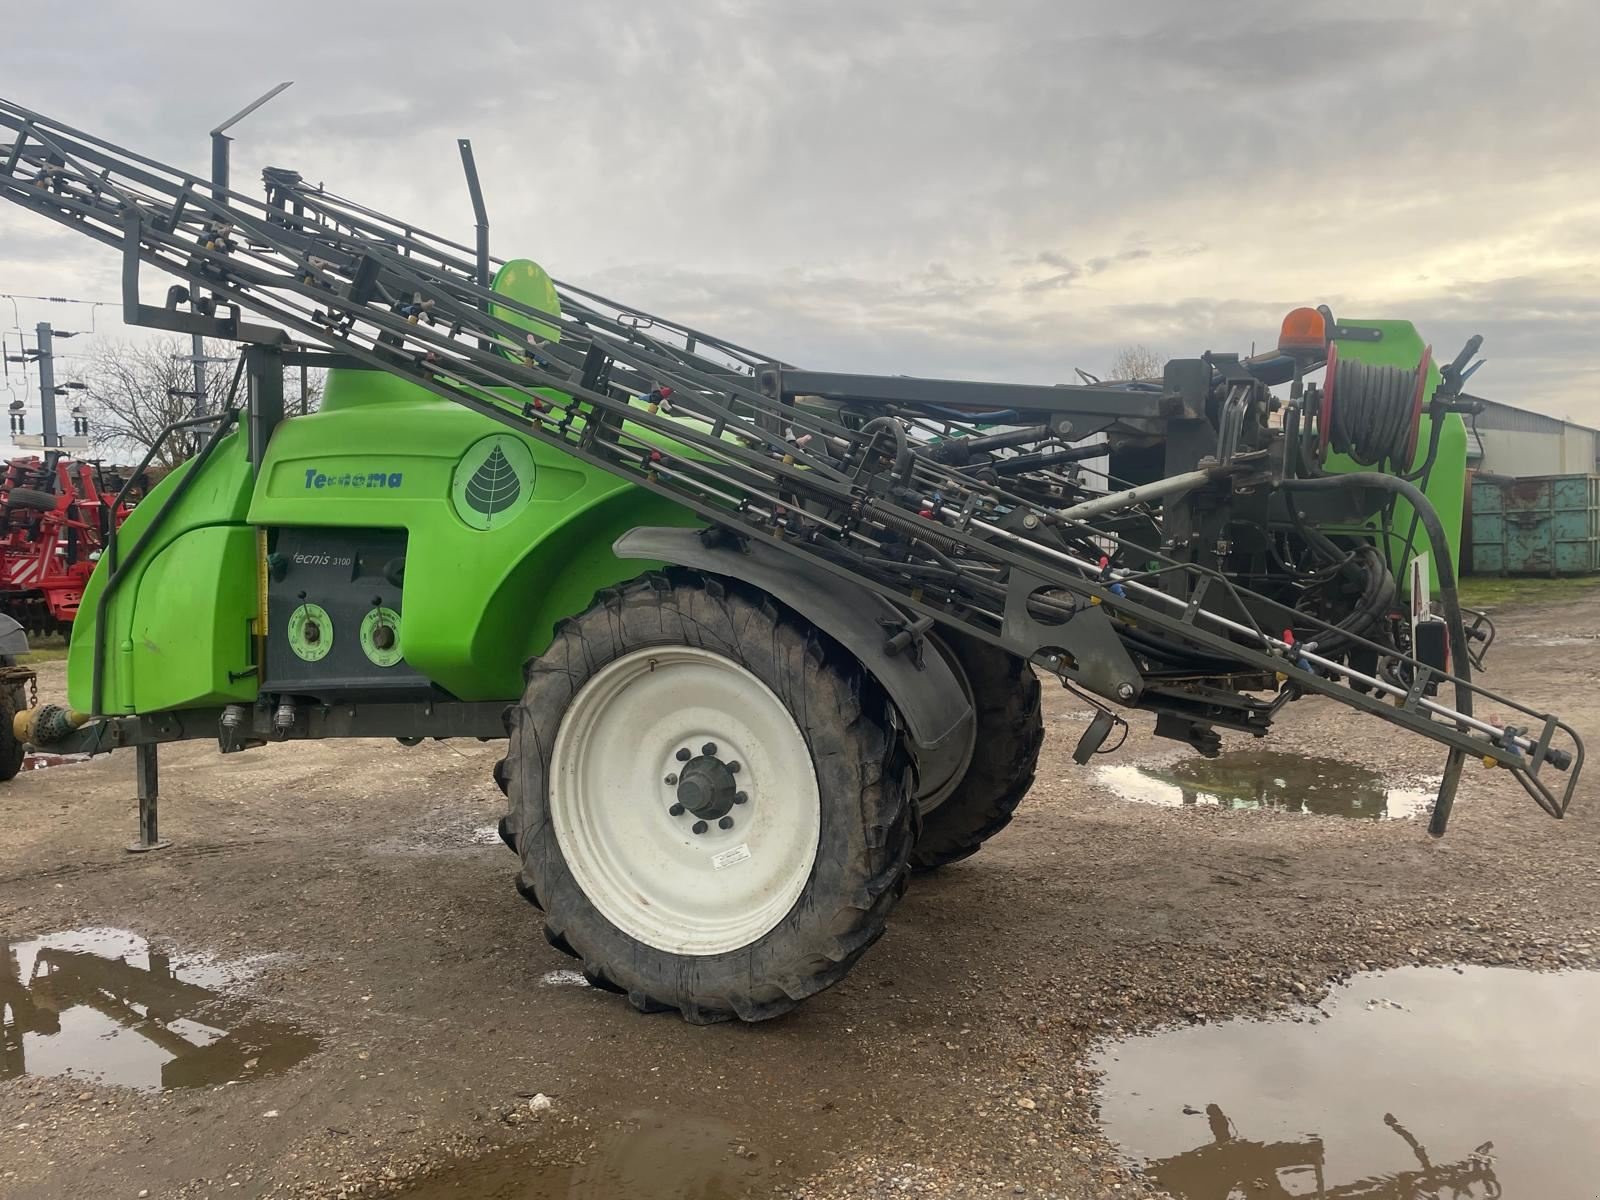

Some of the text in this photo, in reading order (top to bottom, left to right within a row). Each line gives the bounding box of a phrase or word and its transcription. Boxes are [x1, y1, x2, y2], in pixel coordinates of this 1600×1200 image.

[305, 469, 402, 489] Tecnoma
[293, 552, 351, 566] tecnis 3100
